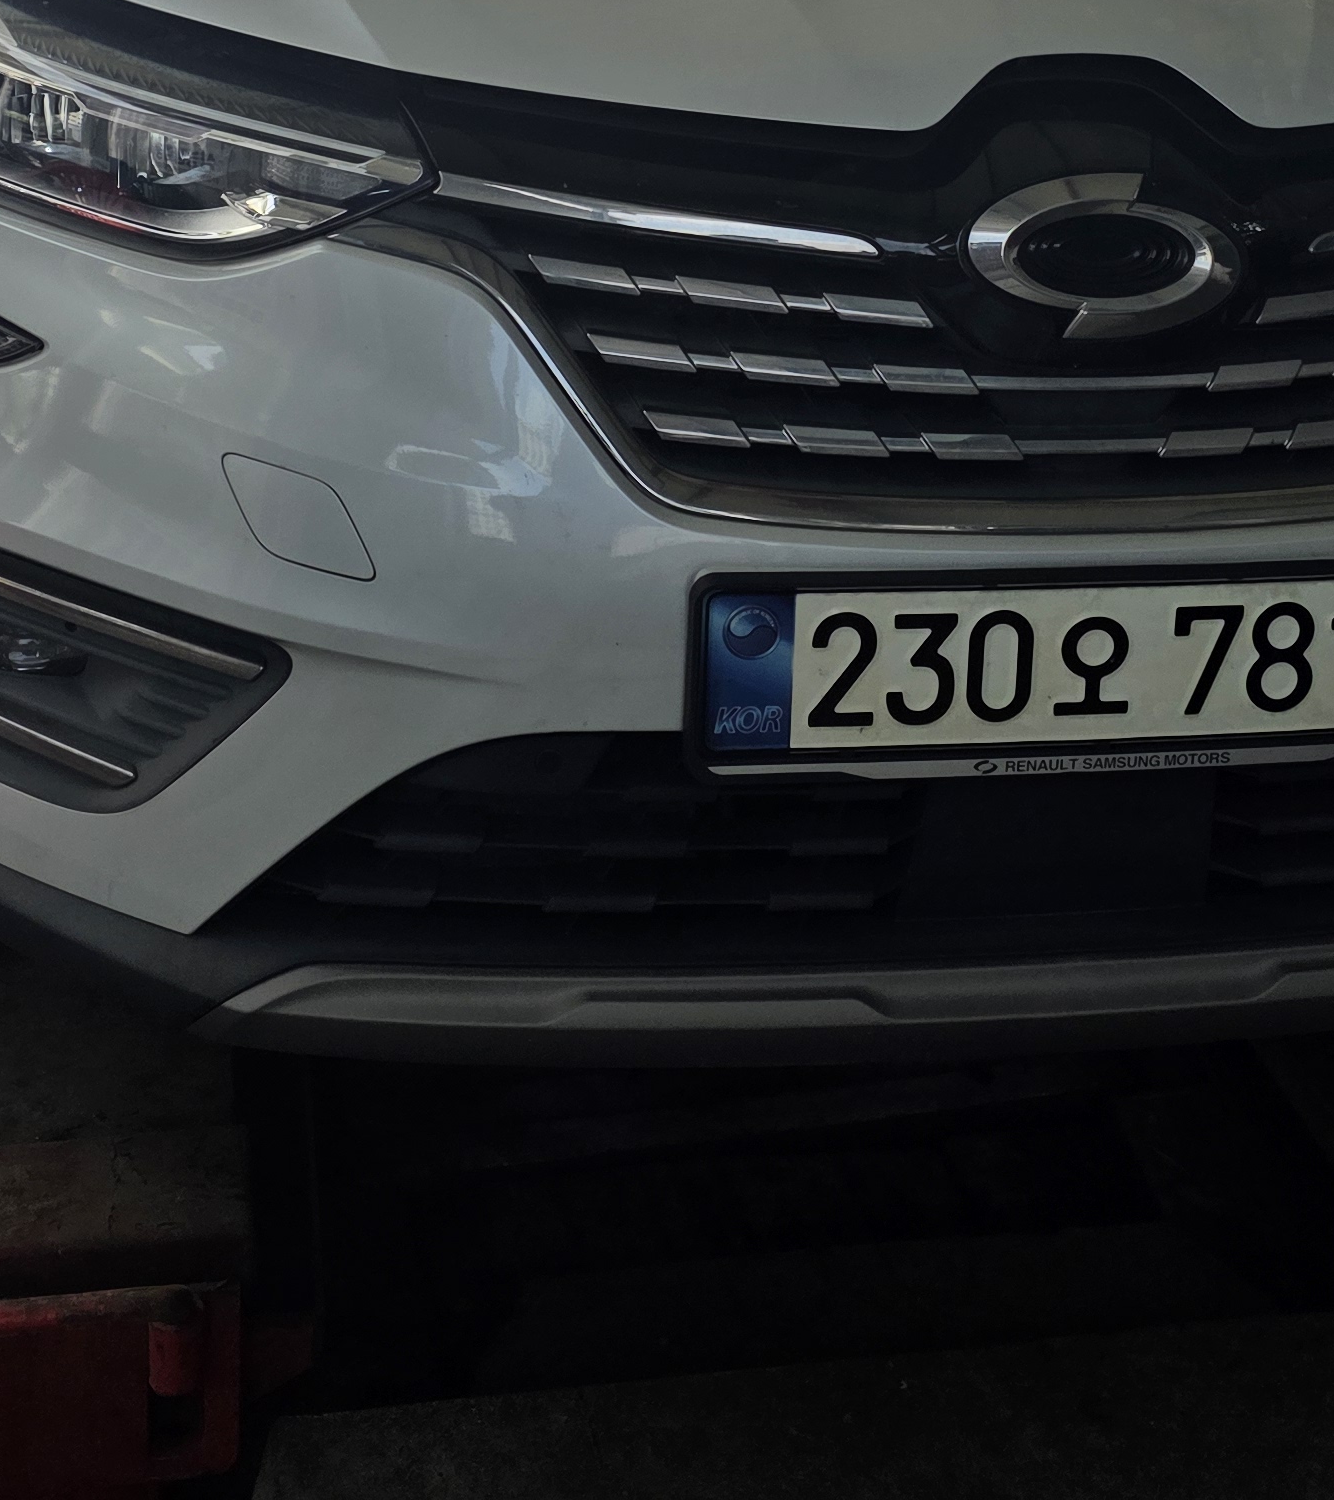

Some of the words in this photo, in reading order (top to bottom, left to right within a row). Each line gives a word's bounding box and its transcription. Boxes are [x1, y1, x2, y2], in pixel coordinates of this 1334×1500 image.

[807, 608, 1131, 729] 230오
[713, 705, 783, 734] KOR
[1004, 758, 1079, 773] RENAULT
[1082, 754, 1161, 770] SAMSUNG
[1163, 751, 1231, 767] MOTORS
